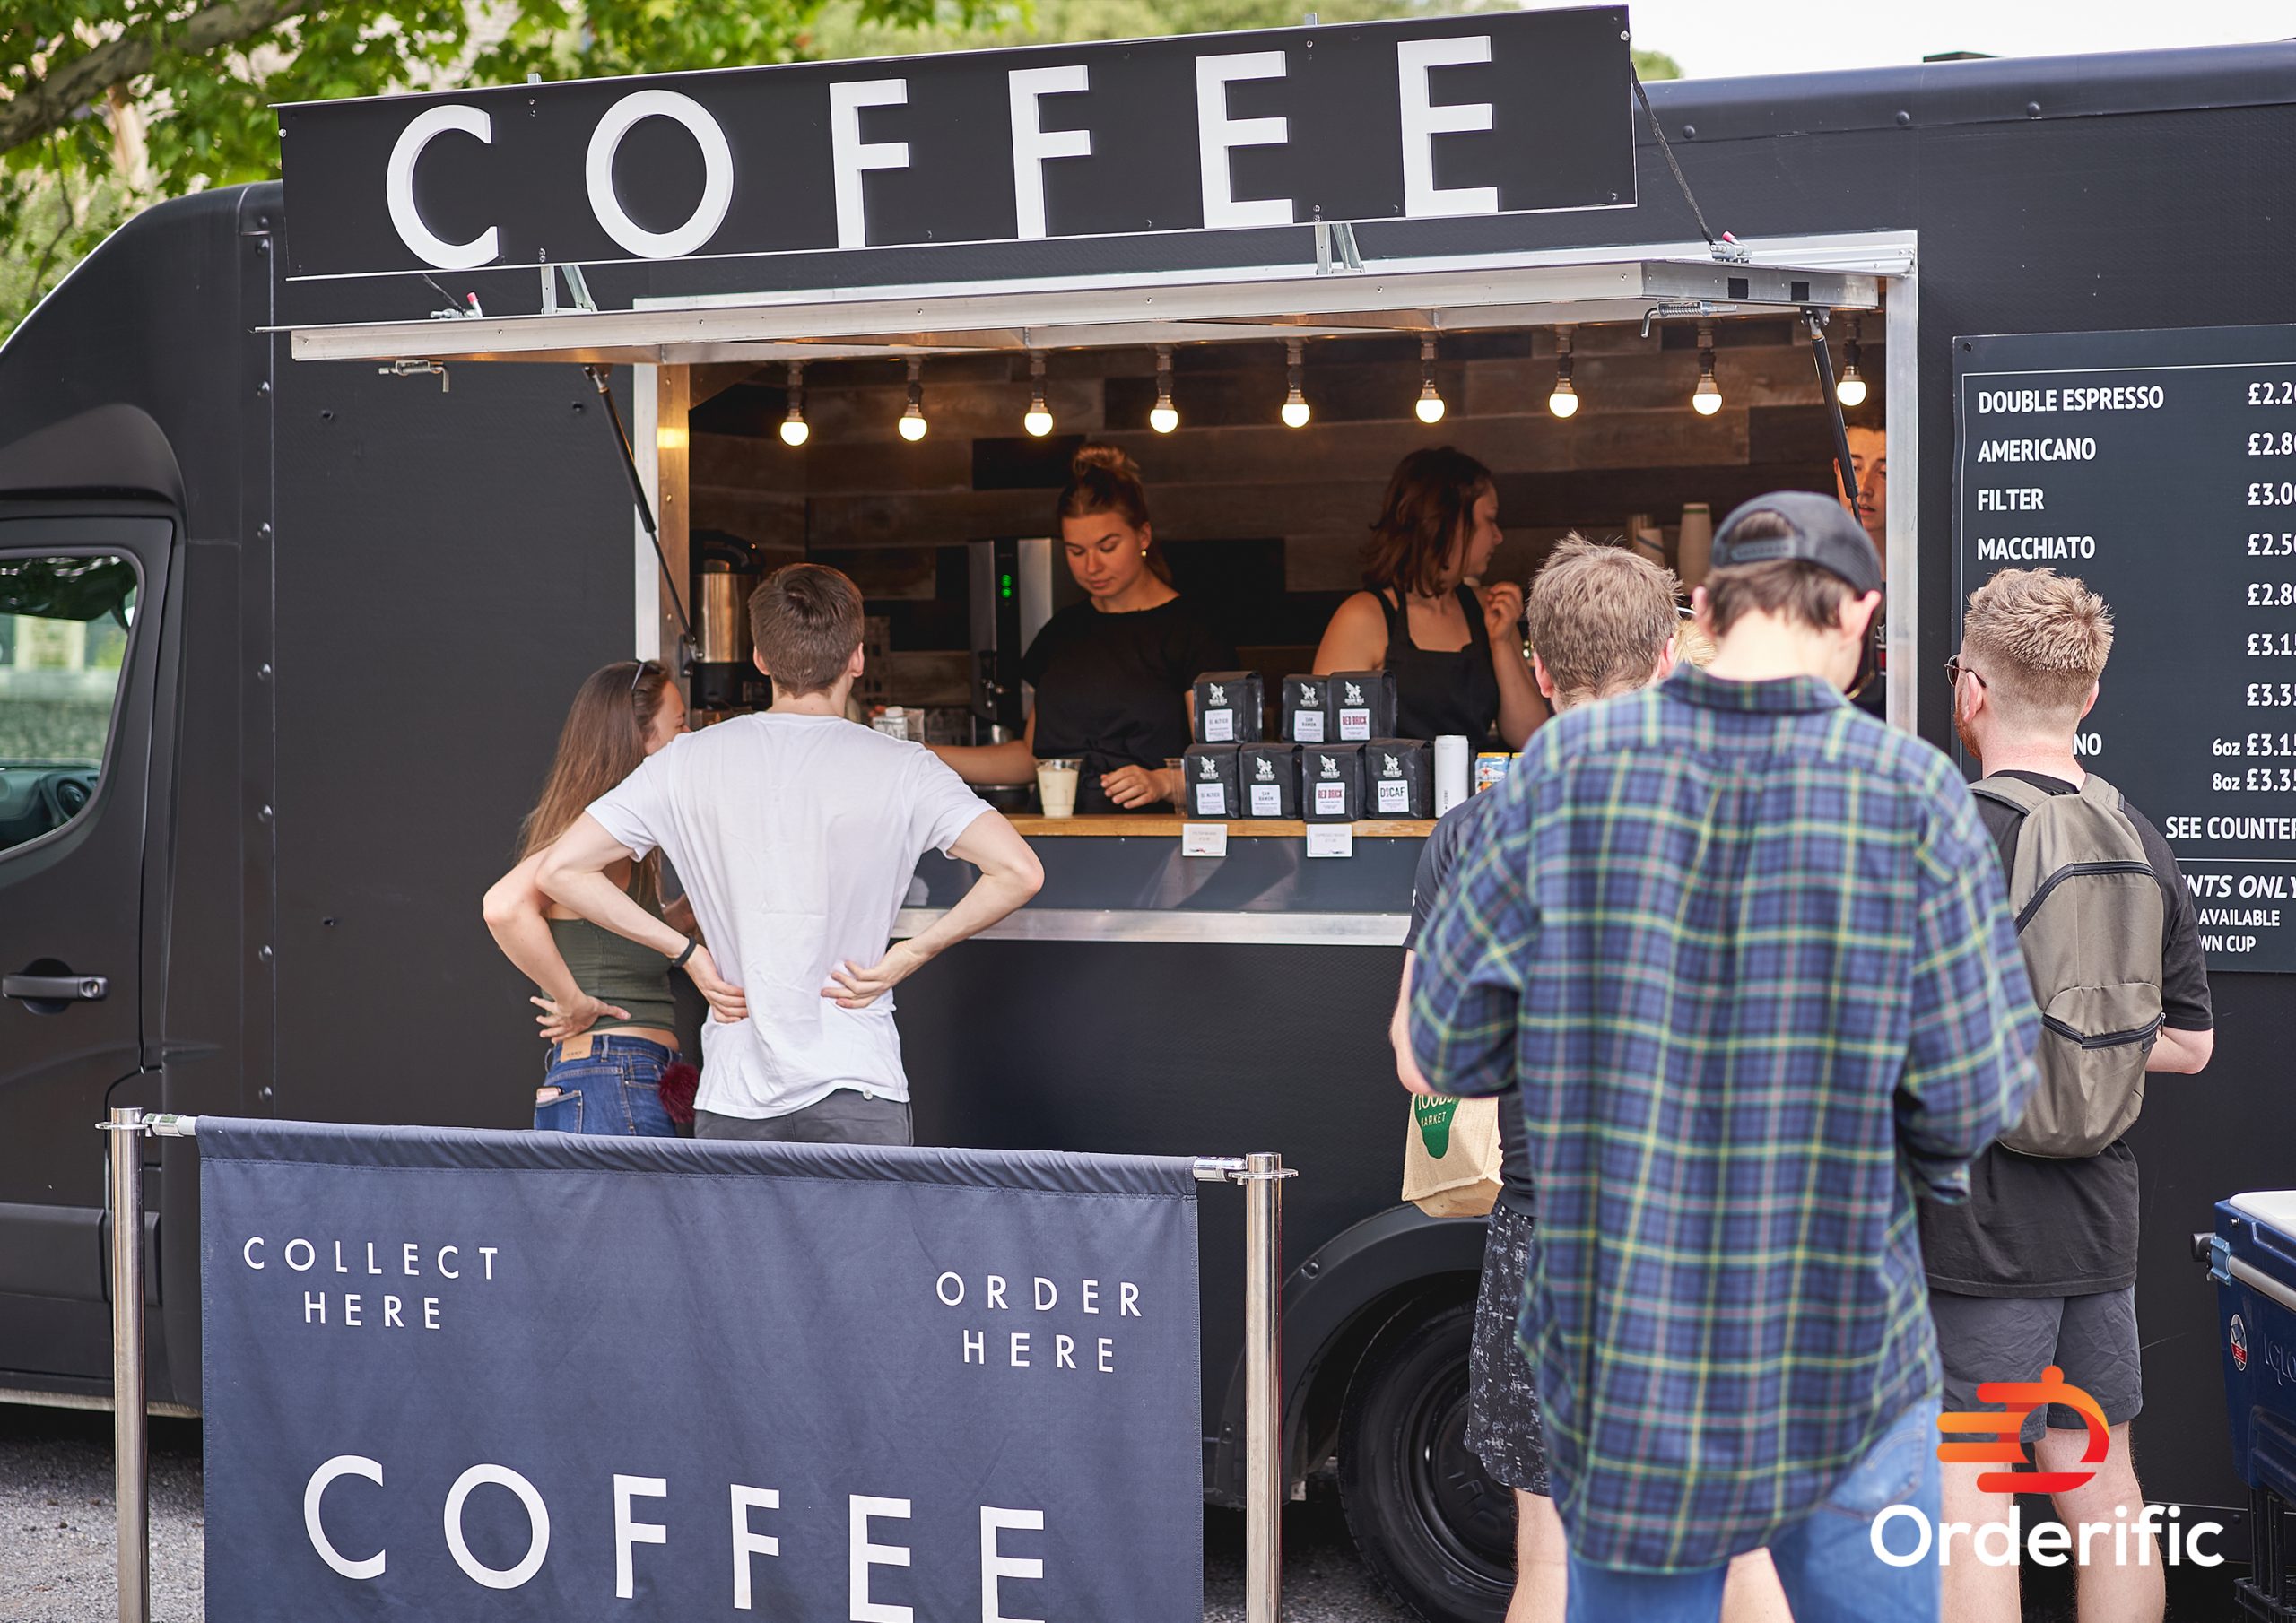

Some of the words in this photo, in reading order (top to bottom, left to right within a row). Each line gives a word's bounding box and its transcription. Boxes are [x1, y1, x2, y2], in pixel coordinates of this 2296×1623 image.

[386, 35, 1500, 270] COFFEE
[1979, 389, 2057, 414] DOUBLE
[2062, 386, 2164, 412] ESPRESSO
[2248, 381, 2296, 405] £2.2
[1977, 437, 2097, 463] AMERICANO
[2248, 431, 2296, 456] £2.8
[1978, 488, 2045, 511] FILTER
[2248, 482, 2296, 506] £3.0
[1977, 535, 2096, 560] MACCHIATO
[2248, 533, 2296, 556] £2.5
[2247, 582, 2296, 606] £2.8
[2247, 632, 2296, 656] £3.1
[2247, 683, 2296, 707] £3.3
[2212, 737, 2241, 756] 6oz
[2212, 772, 2241, 791] 8oz
[2165, 816, 2202, 839] SEE
[2198, 908, 2281, 927] AVAILABLE
[2226, 934, 2257, 953] CUP
[243, 1237, 499, 1280] COLLECT
[935, 1271, 1142, 1317] ORDER
[304, 1291, 441, 1330] HERE
[963, 1329, 1114, 1373] HERE
[303, 1454, 1047, 1623] COFFEE
